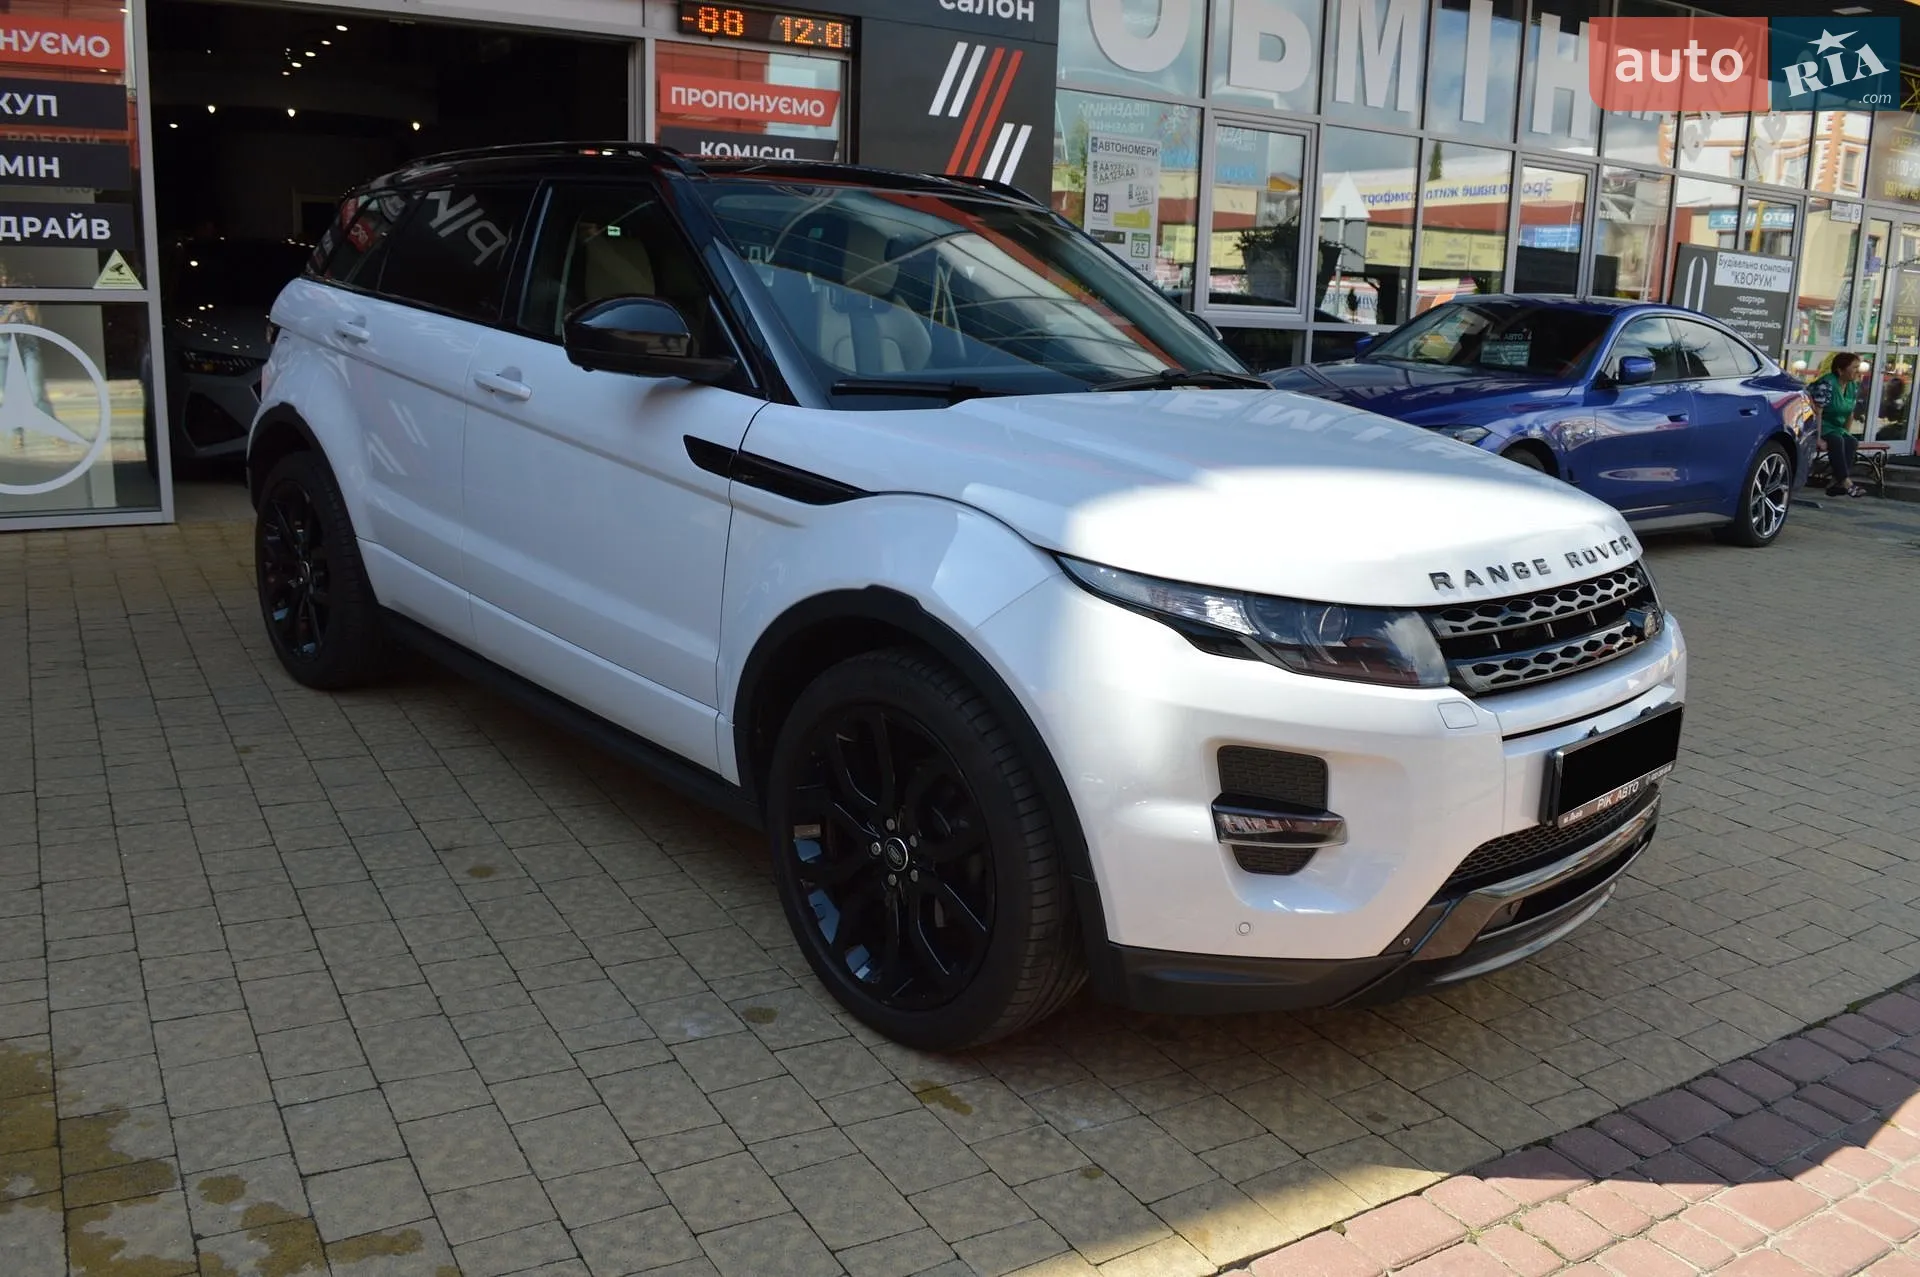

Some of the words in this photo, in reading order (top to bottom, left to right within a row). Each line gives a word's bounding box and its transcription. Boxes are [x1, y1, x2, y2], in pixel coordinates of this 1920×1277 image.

[671, 86, 825, 118] ПРОПОНУЄМО
[700, 141, 795, 160] КОМІСІЯ
[1098, 142, 1159, 158] АВТОНОМЕРИ
[1094, 195, 1108, 212] 25
[1731, 270, 1777, 288] "КВОРУМ"
[1429, 557, 1552, 591] RANGE
[1564, 535, 1634, 569] ROVER
[1615, 781, 1640, 802] АВТО
